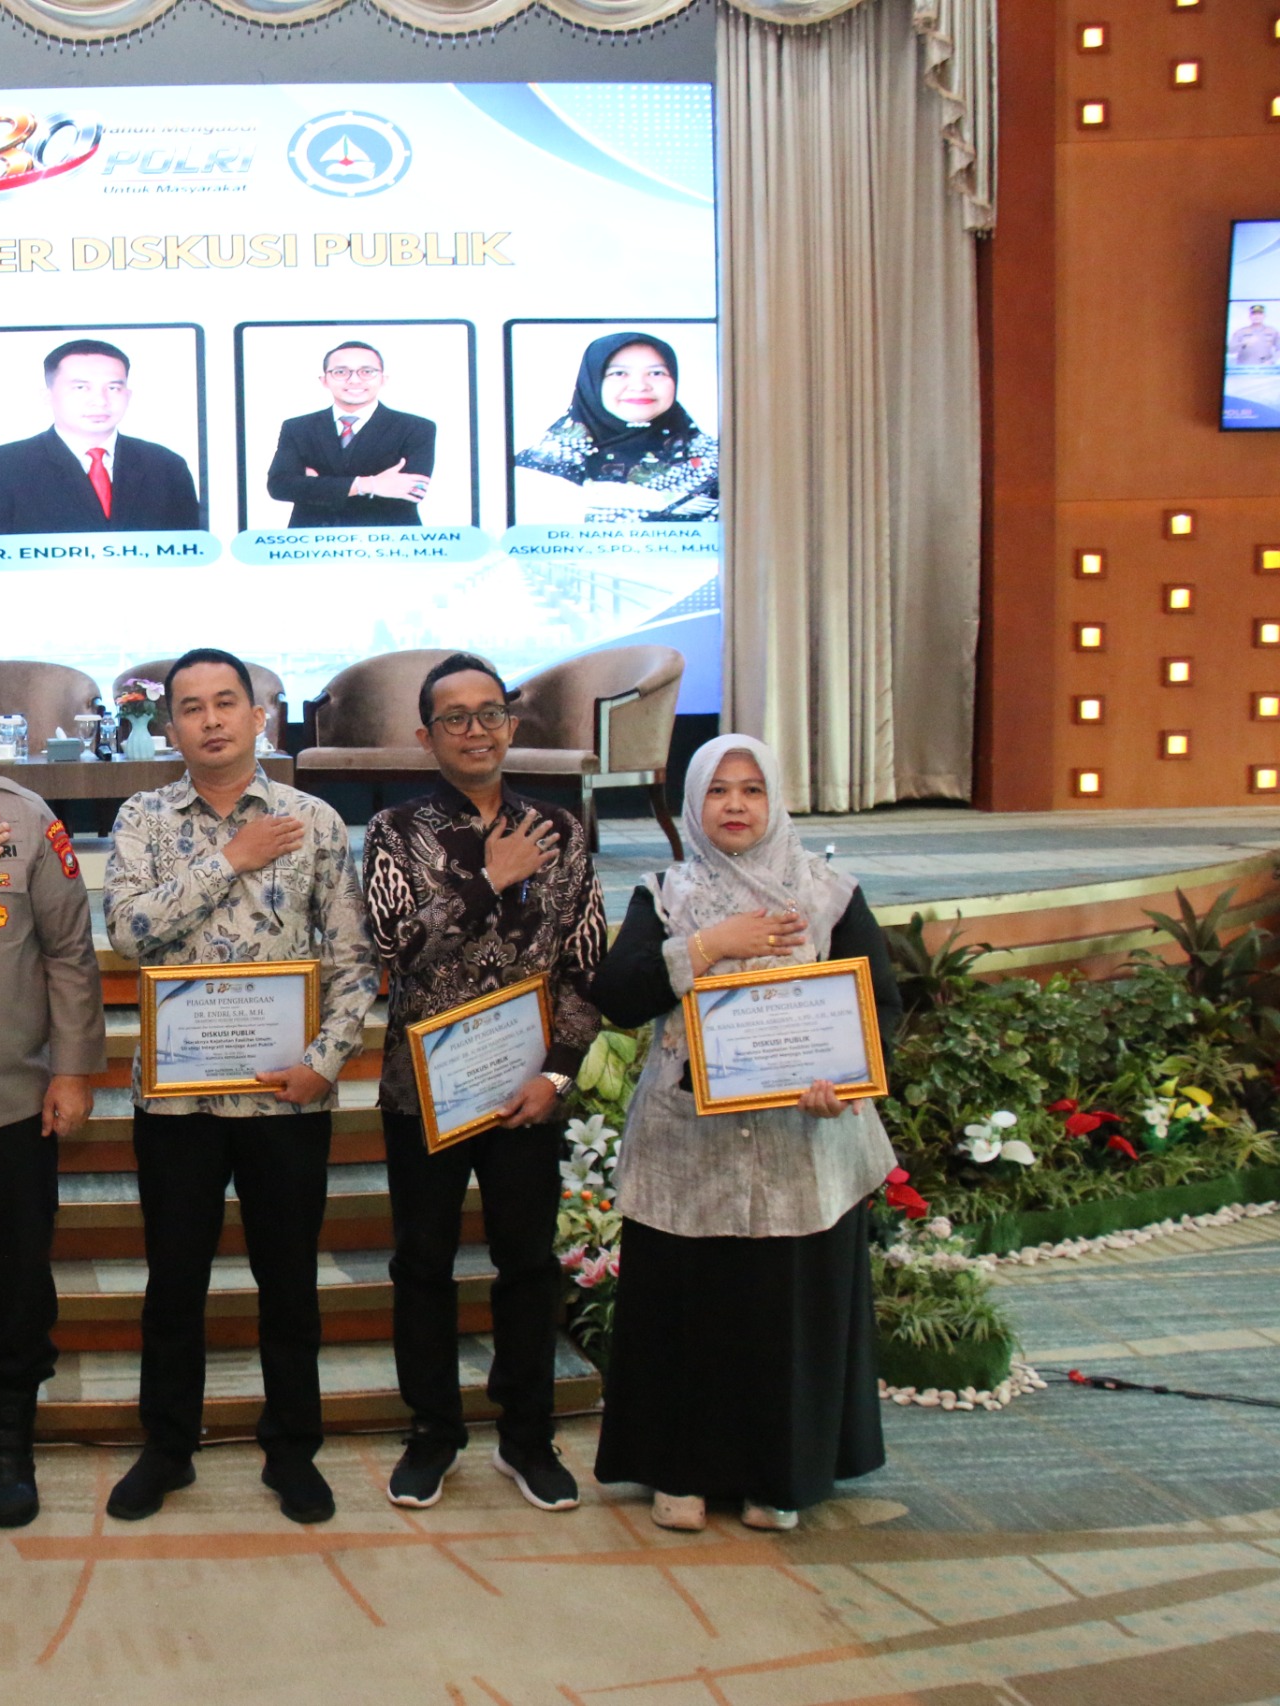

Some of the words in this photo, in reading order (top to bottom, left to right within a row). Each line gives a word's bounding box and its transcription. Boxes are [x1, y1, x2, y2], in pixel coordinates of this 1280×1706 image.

[100, 144, 258, 176] POLRI
[103, 184, 150, 194] Untuk
[156, 183, 247, 195] Masyarakat
[71, 233, 298, 271] DISKUSI
[314, 231, 516, 268] PUBLIK
[254, 535, 310, 545] ASSOC
[314, 534, 363, 543] PROF.
[368, 534, 395, 543] DR.
[399, 532, 461, 542] ALWAN
[547, 530, 574, 540] DR.
[579, 529, 624, 539] NANA
[629, 528, 702, 538] RAIHANA
[19, 546, 96, 560] ENDRI,
[102, 545, 149, 558] S.H.,
[156, 543, 204, 556] M.H.
[269, 549, 371, 559] HADIYANTO,
[375, 548, 409, 558] S.H.,
[413, 547, 448, 557] M.H.
[681, 543, 719, 553] M.HU
[186, 998, 216, 1007] PIAGAM
[218, 996, 275, 1005] PENGHARGAAN
[752, 1039, 782, 1048] DISKUSI
[784, 1036, 810, 1044] PUBLIK
